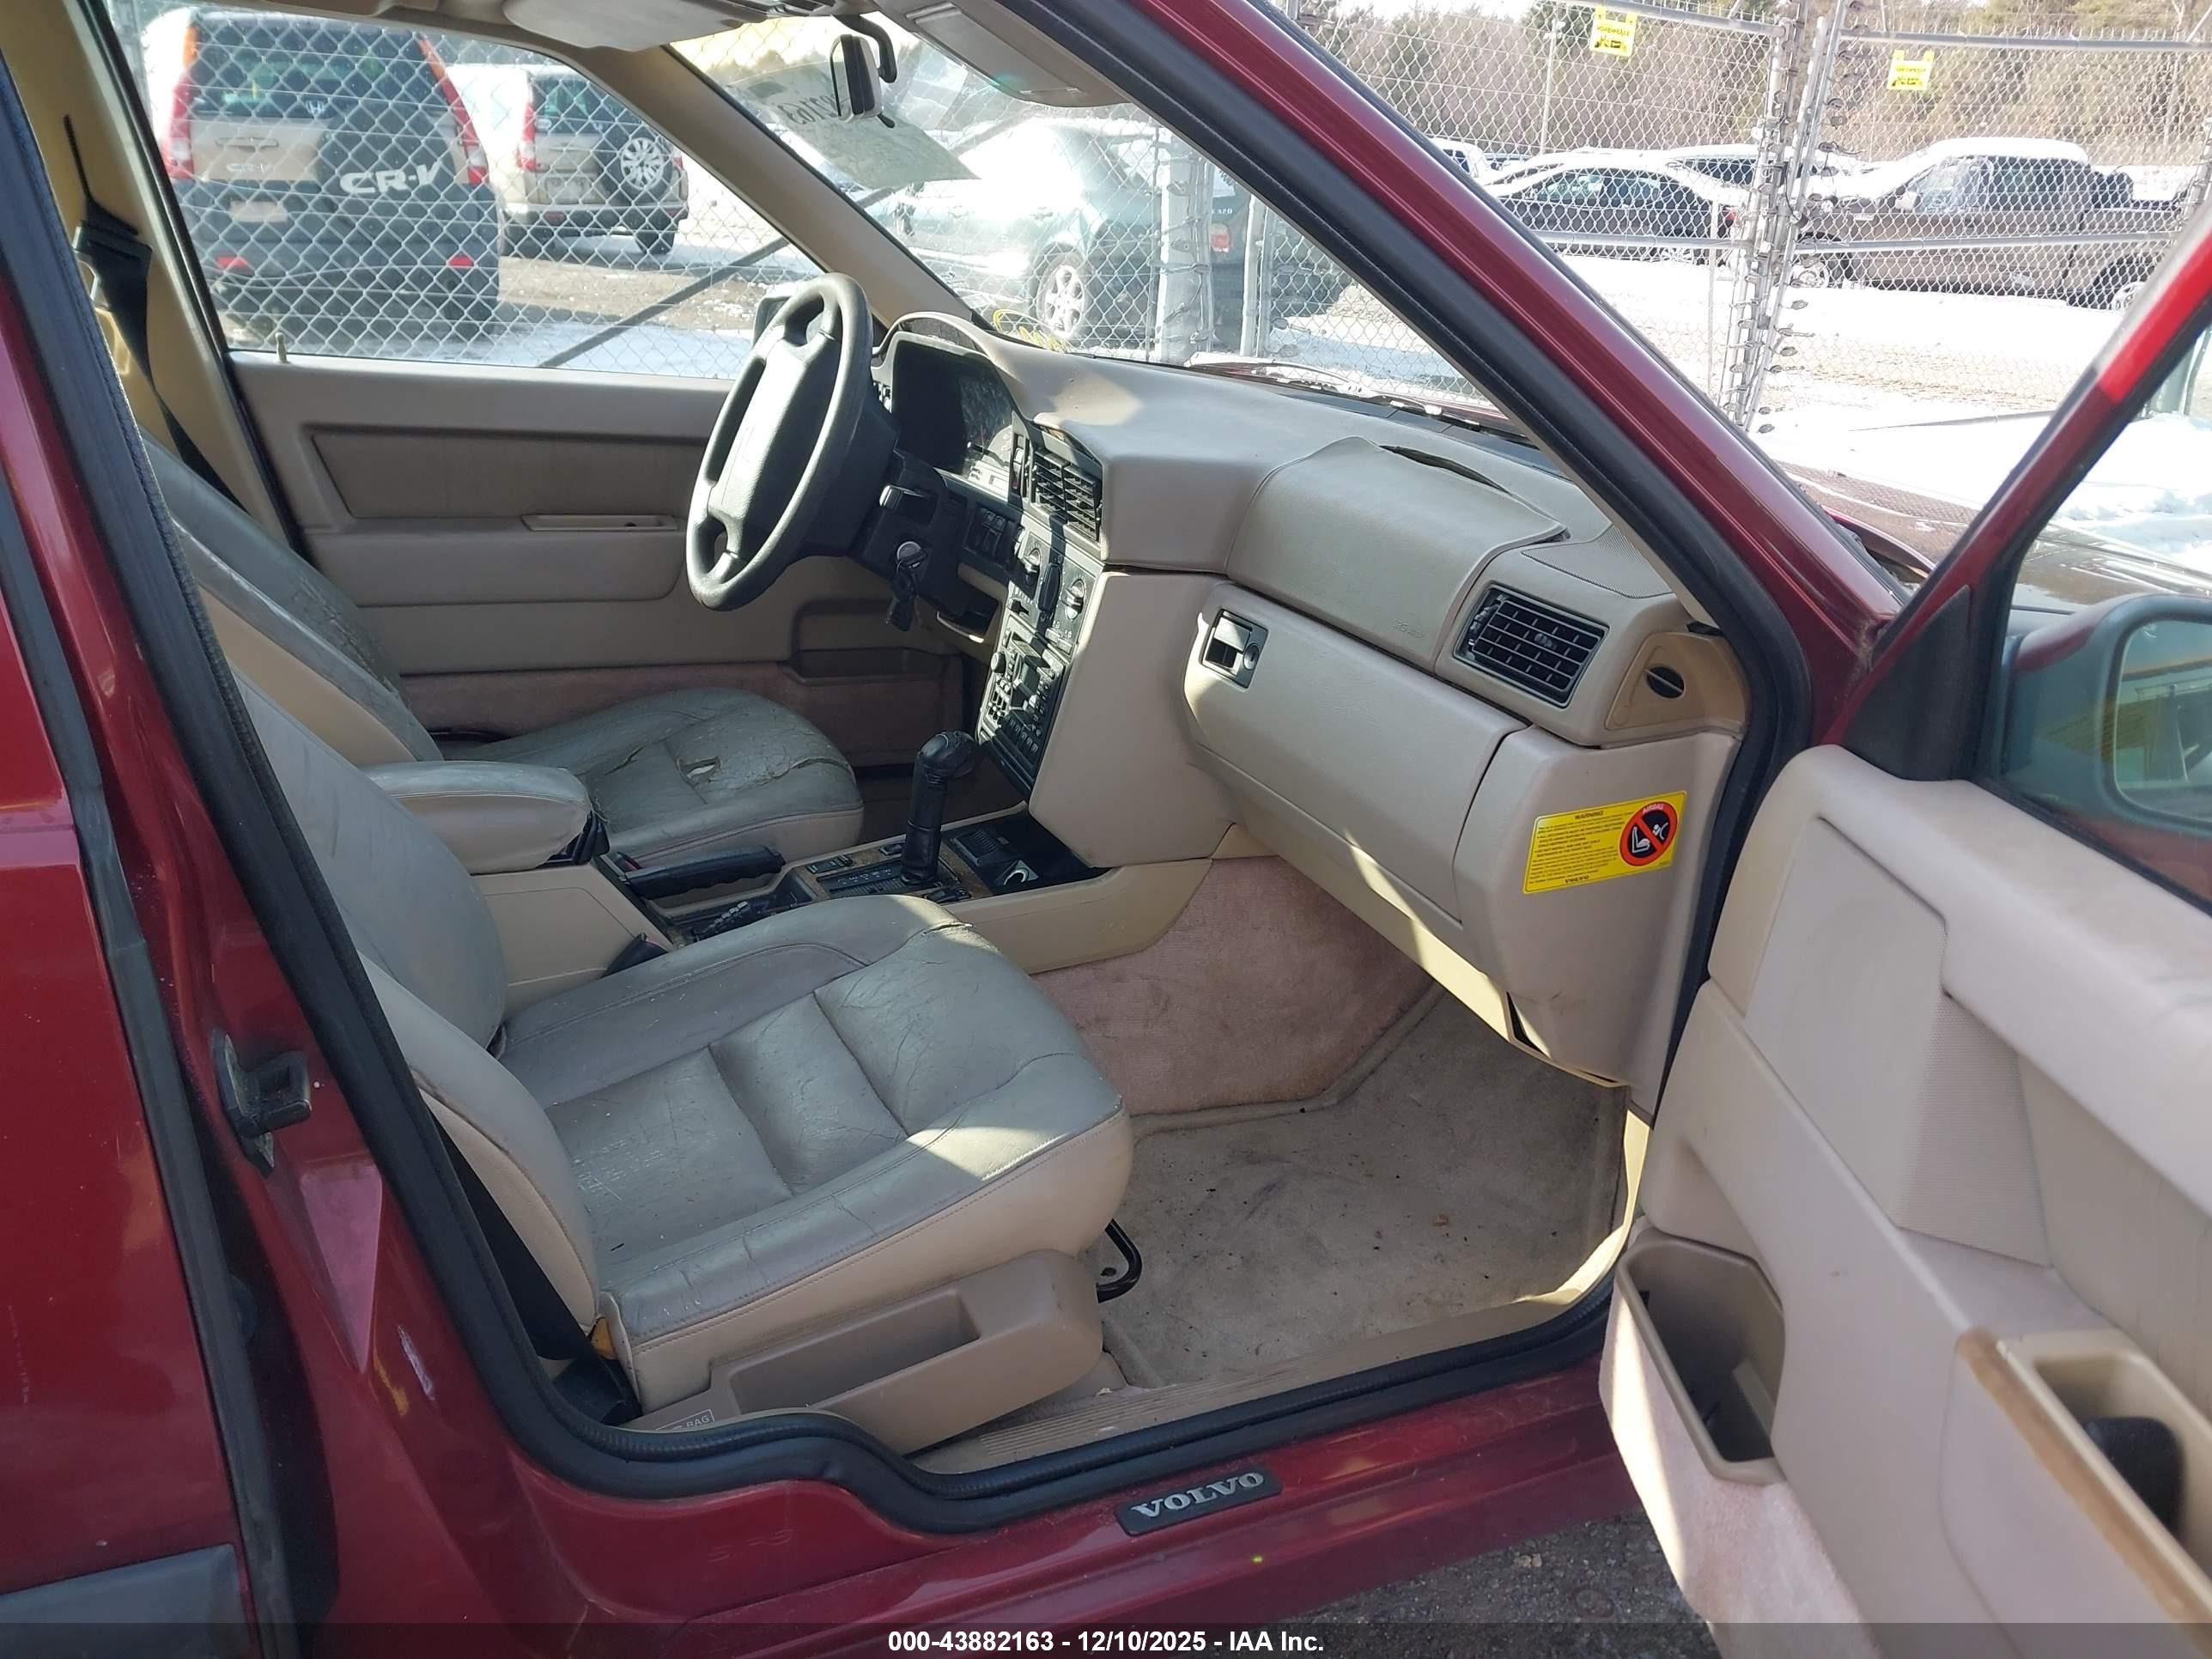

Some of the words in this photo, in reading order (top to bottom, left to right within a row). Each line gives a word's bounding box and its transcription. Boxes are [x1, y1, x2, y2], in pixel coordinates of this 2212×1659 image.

[339, 161, 442, 194] CR-V
[686, 1414, 709, 1428] BAG
[1130, 1472, 1265, 1518] VOLVO
